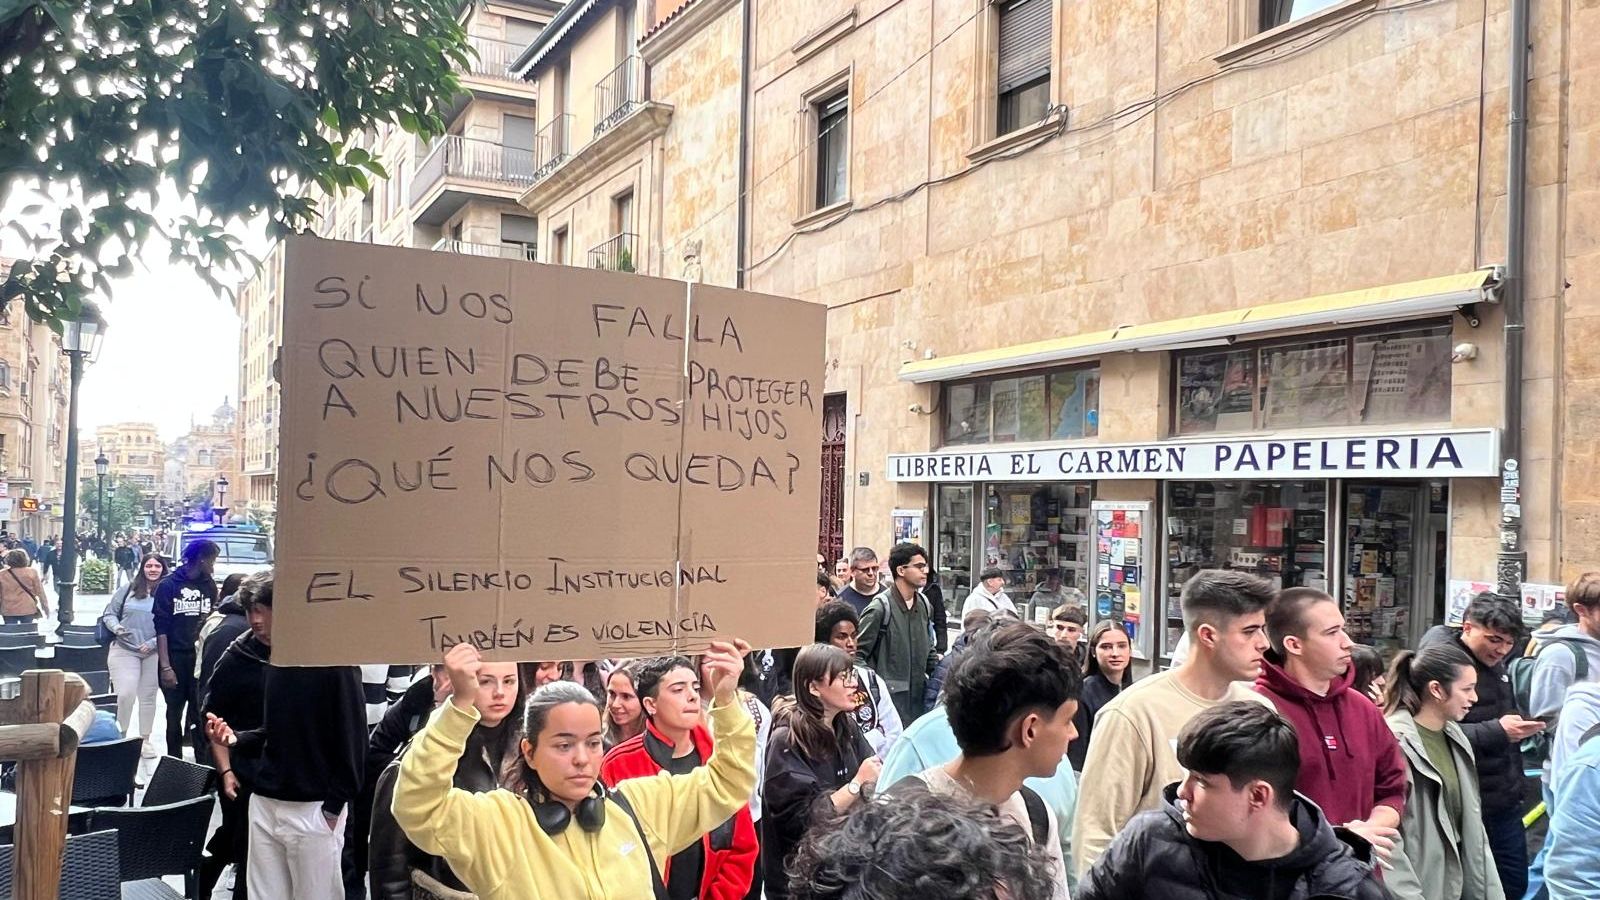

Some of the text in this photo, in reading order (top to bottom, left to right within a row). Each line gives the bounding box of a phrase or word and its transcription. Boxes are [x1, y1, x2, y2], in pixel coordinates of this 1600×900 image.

[416, 283, 513, 324] NOS
[592, 303, 743, 352] FALLA
[318, 338, 814, 415] QUIEN DEBE PROTEGER
[322, 384, 358, 421] A
[396, 385, 681, 426] NUESTROS
[296, 446, 800, 504] ¿QUÉ NOS QUEDA?
[896, 437, 1463, 477] LIBRERIA EL CARMEN PAPELERIA
[306, 557, 727, 602] EL SILENCIO INSTITUCIONAL
[544, 624, 579, 643] ES
